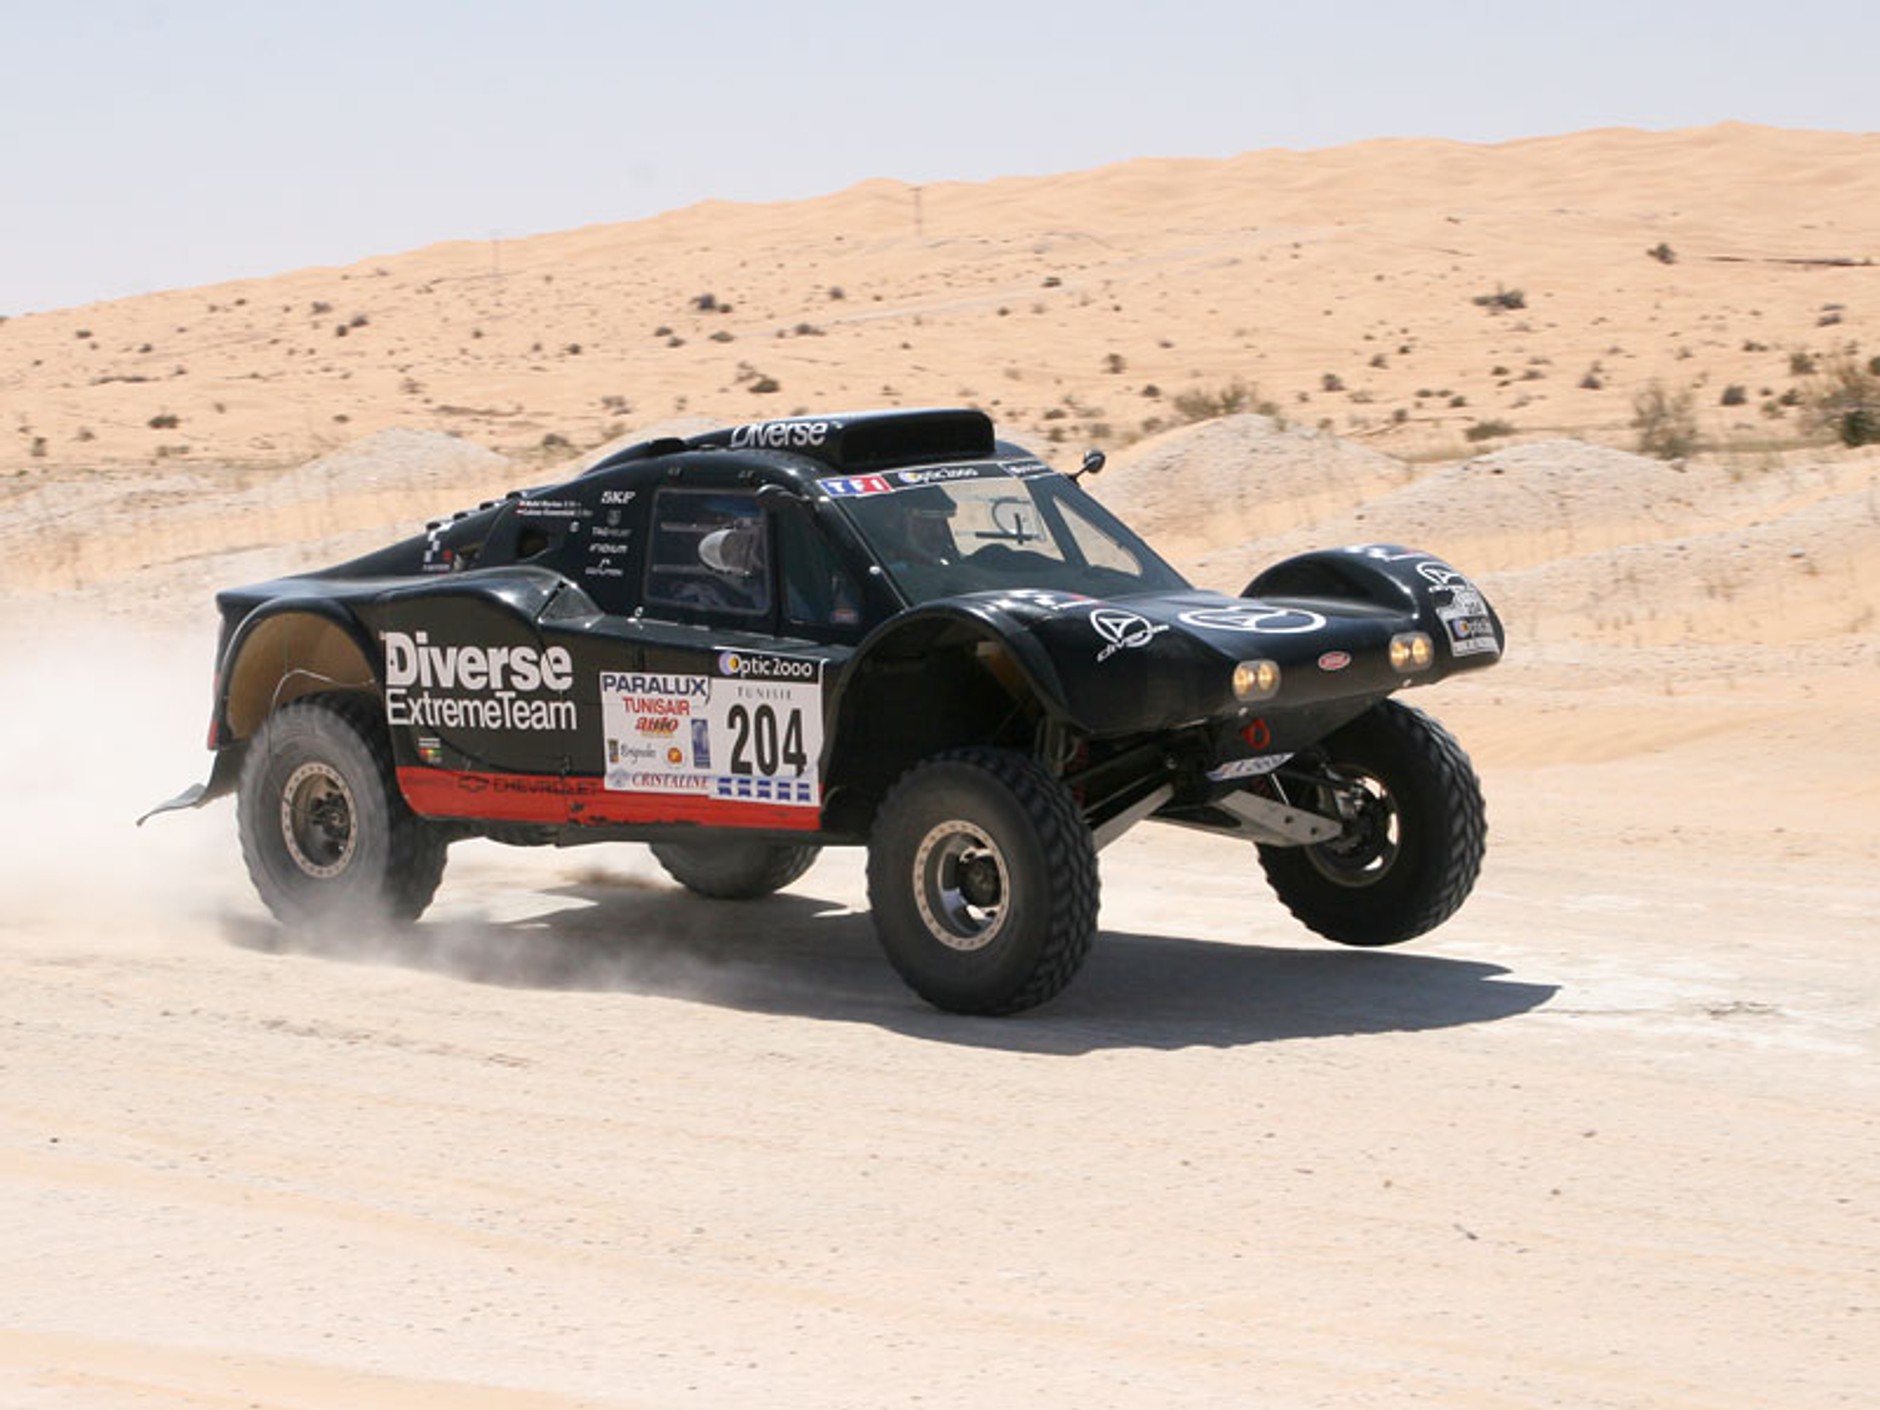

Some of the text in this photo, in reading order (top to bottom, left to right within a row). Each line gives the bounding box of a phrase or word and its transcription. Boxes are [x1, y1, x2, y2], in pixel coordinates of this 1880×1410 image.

[731, 422, 829, 448] Diverse
[829, 479, 885, 495] TF1
[601, 491, 636, 504] SKF
[385, 631, 573, 691] Diverse
[602, 674, 706, 697] PARALUX
[737, 686, 793, 701] TUNISIE
[622, 697, 691, 716] TUNISAIR
[726, 703, 808, 777] 204
[493, 777, 599, 796] CHEVROLET
[632, 771, 710, 789] CRISTALINE
